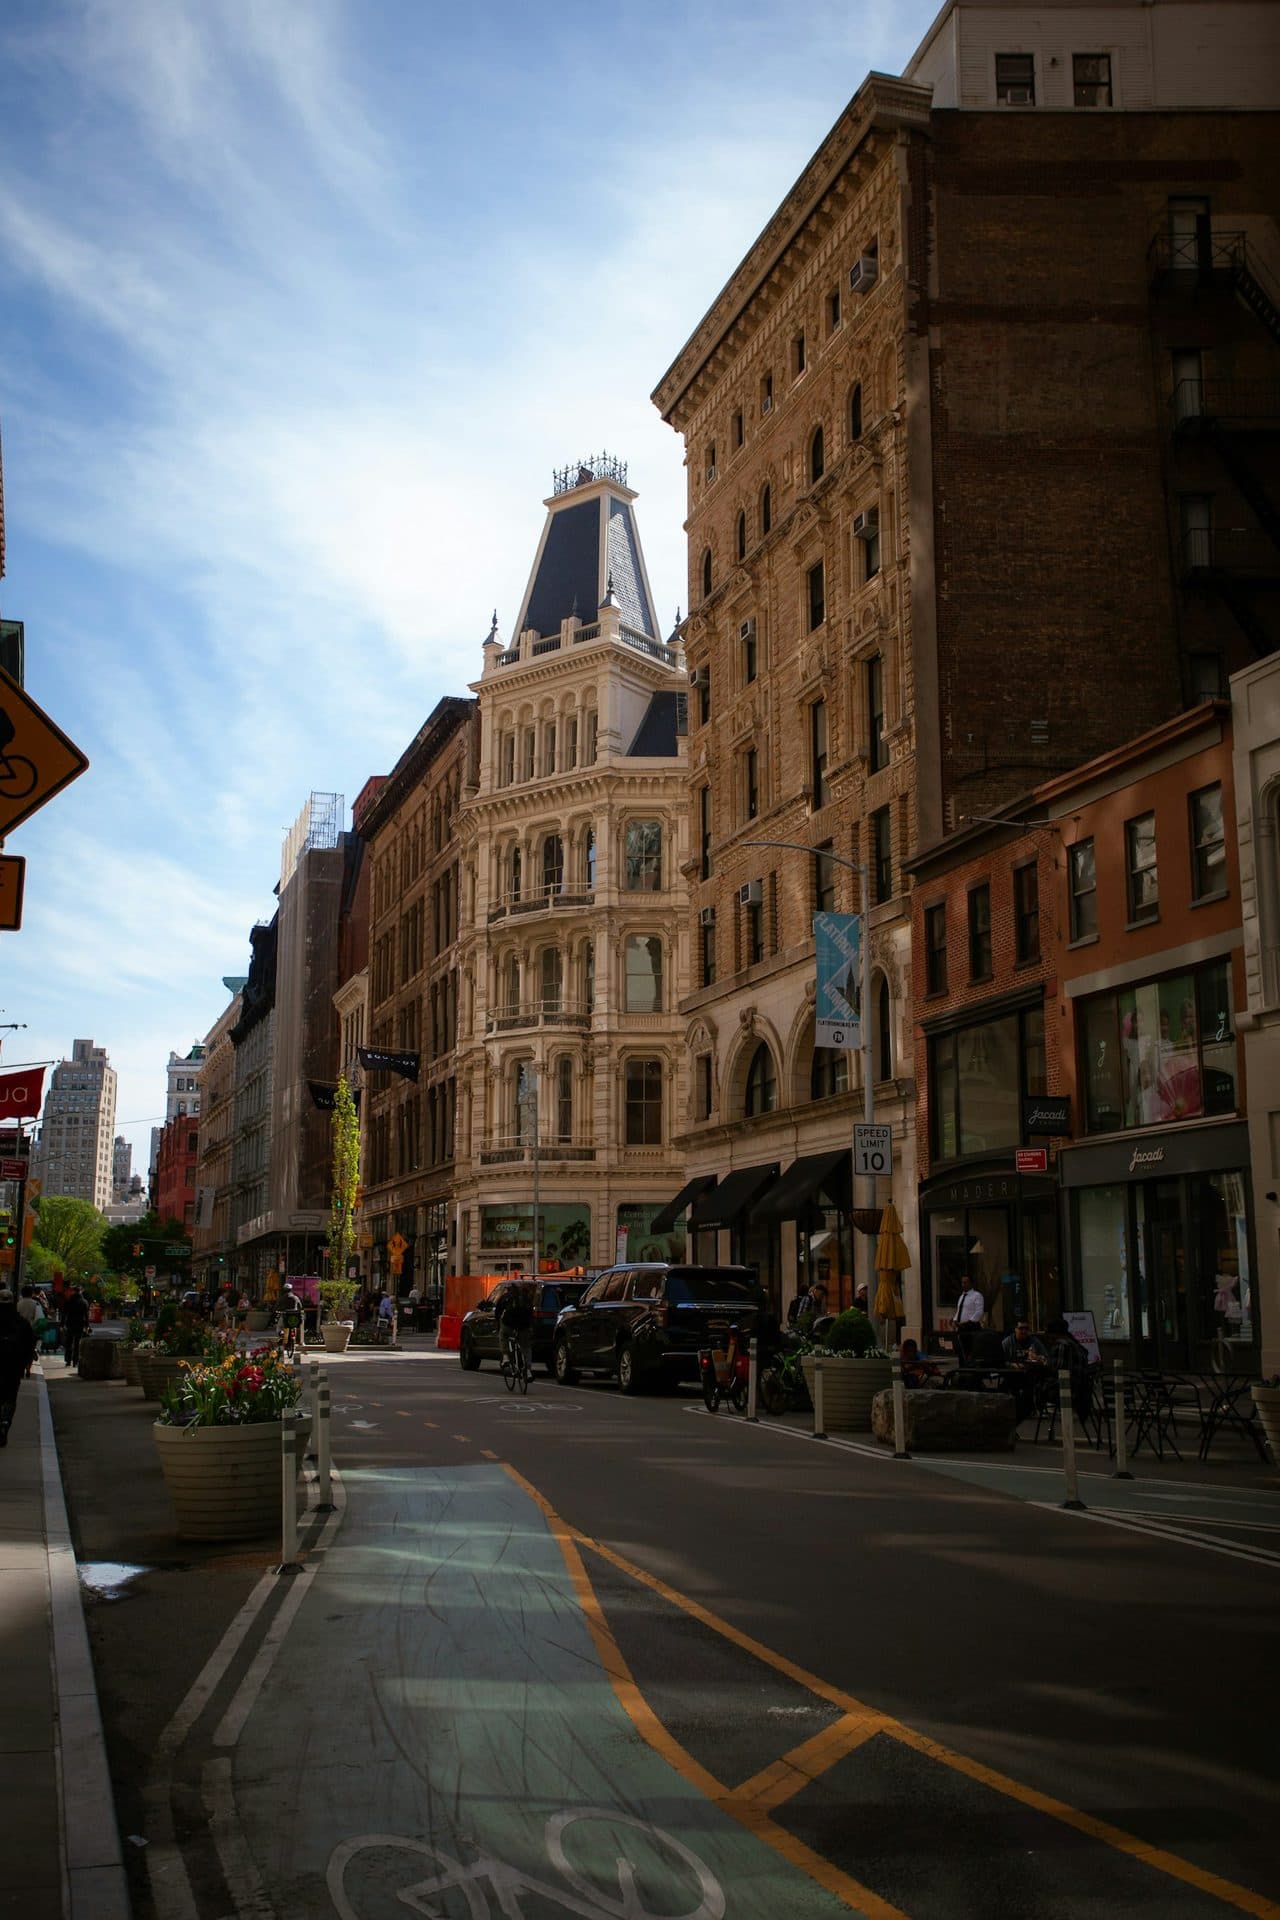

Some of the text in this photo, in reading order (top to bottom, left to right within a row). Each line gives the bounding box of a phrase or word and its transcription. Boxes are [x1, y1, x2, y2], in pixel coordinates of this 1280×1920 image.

[1028, 1105, 1067, 1125] Jacadi
[857, 1129, 888, 1138] SPEED
[860, 1140, 885, 1148] LIMIT
[863, 1152, 884, 1170] 10
[1129, 1147, 1165, 1172] Jacadi
